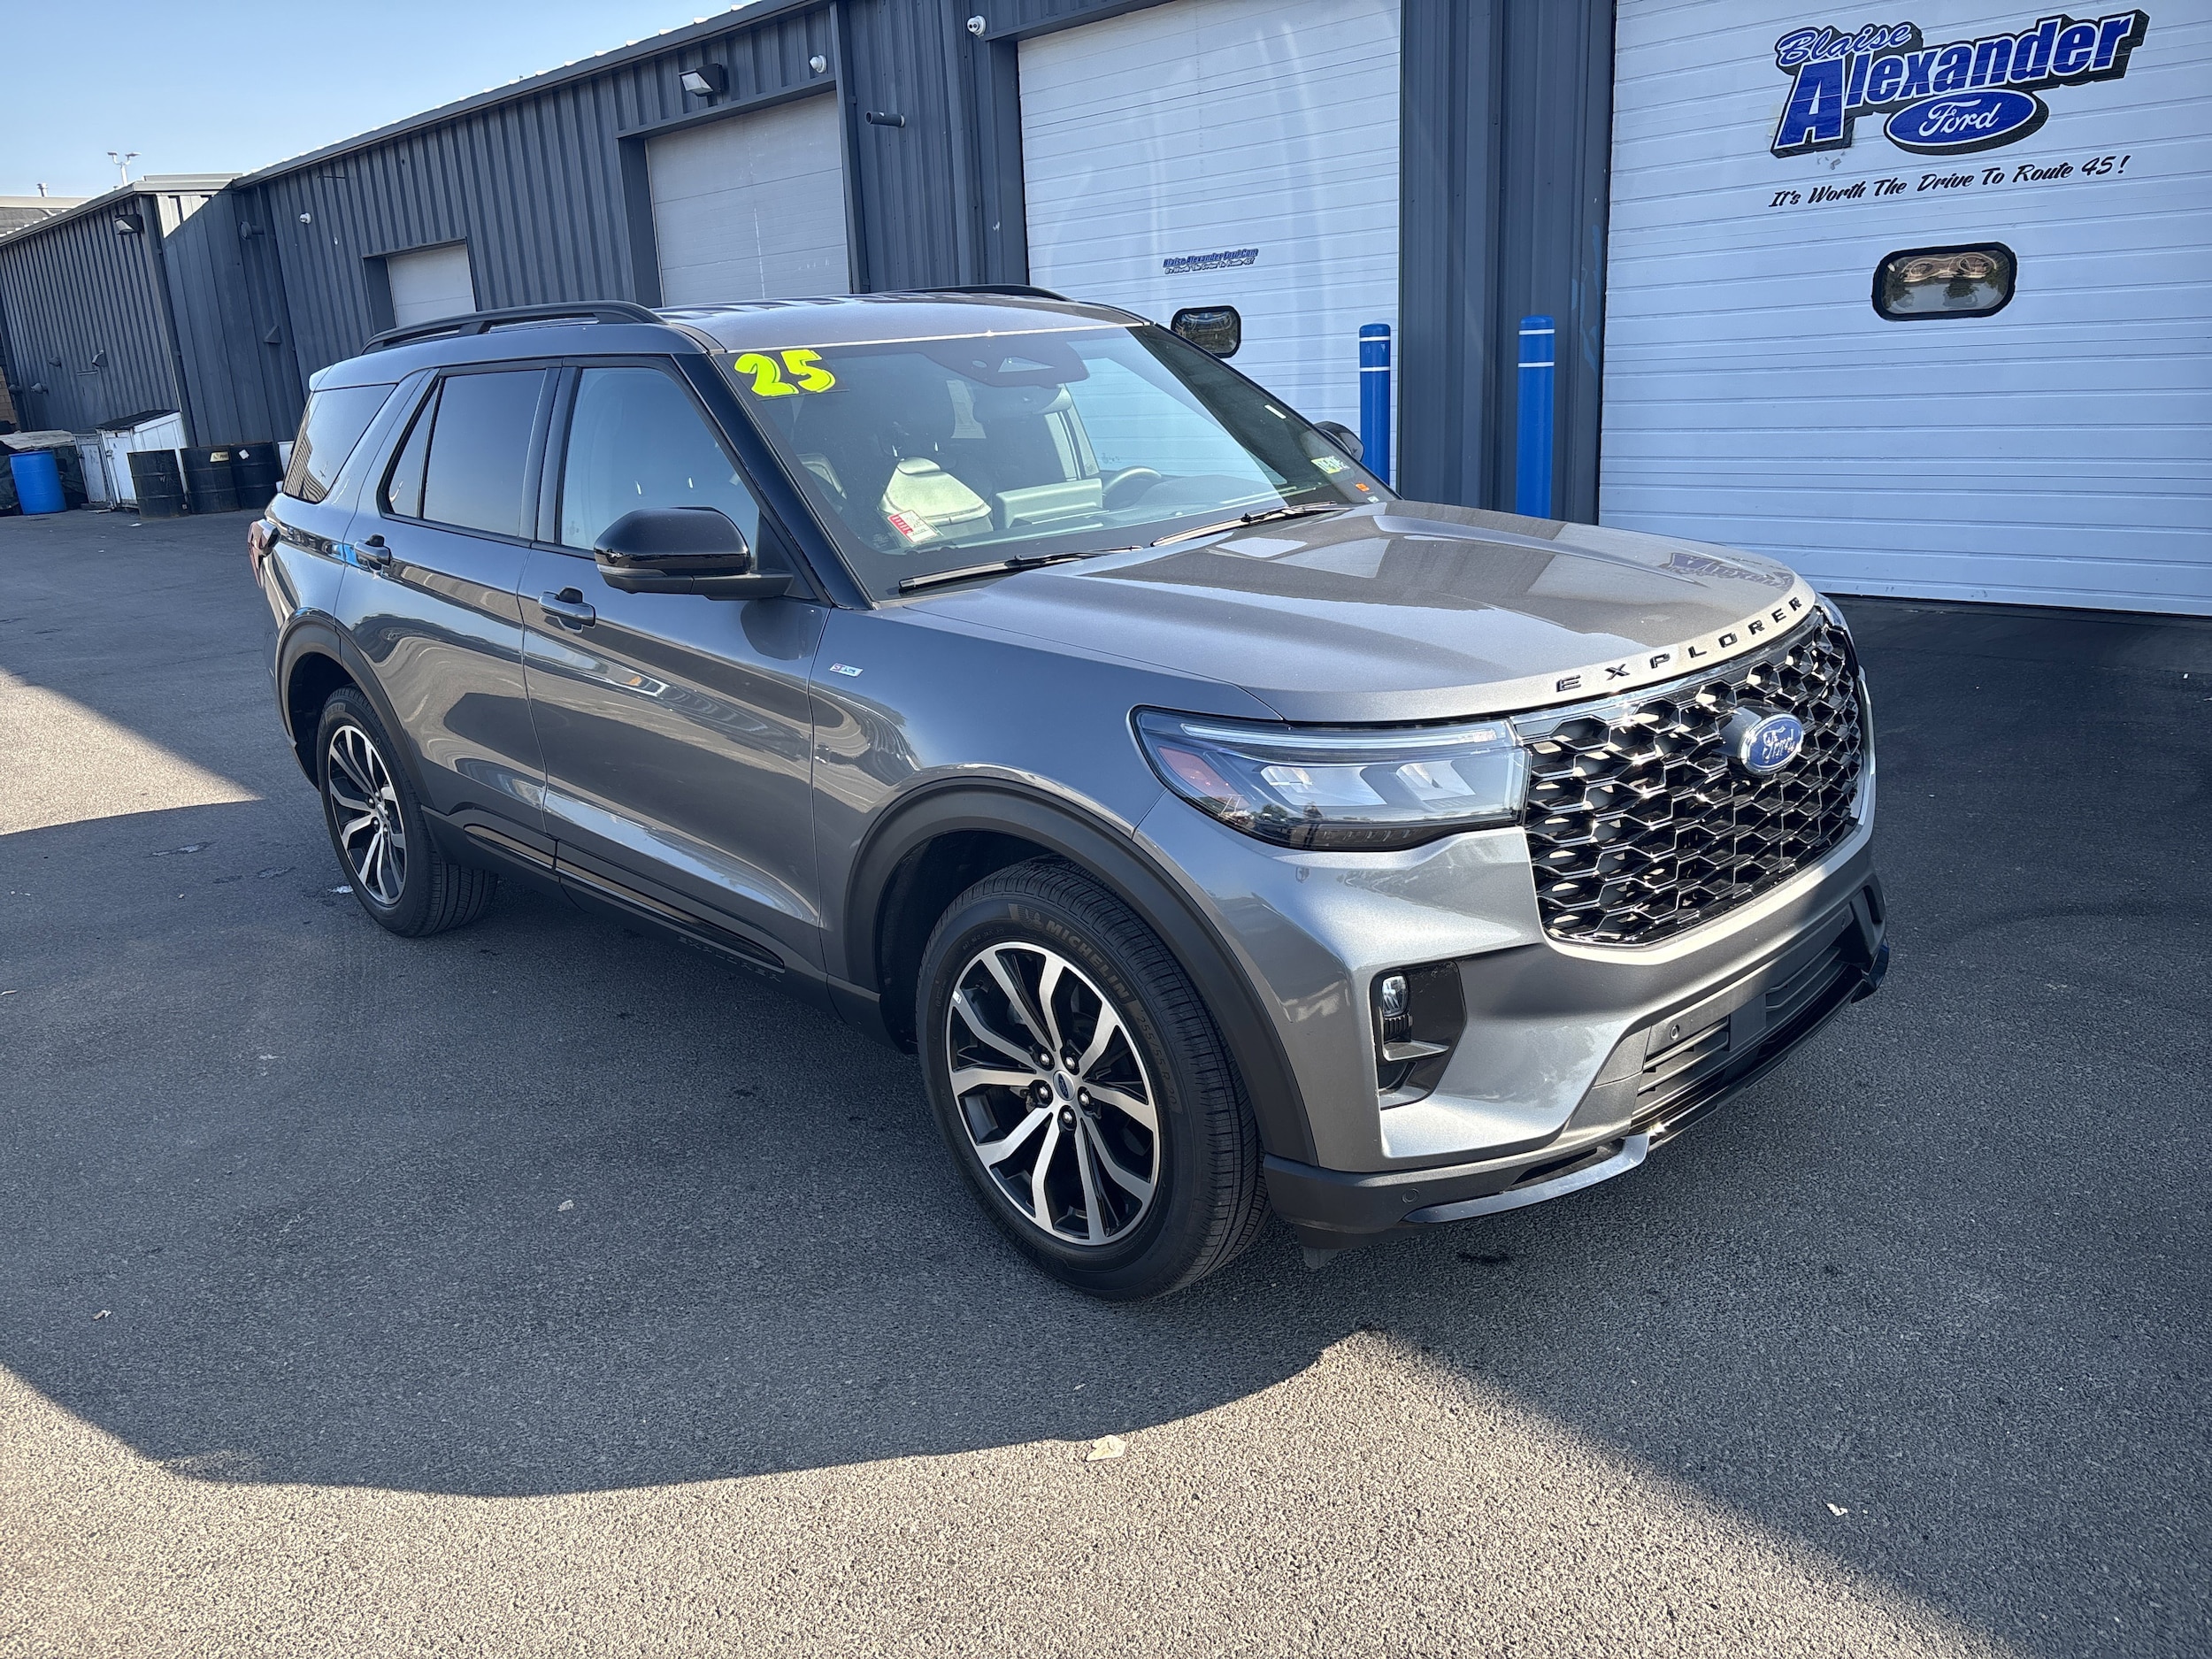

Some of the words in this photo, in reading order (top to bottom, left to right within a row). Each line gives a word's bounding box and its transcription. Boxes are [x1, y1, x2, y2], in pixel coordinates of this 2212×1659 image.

[1778, 24, 1913, 66] Blaise
[1772, 12, 2138, 150] Alexander
[1918, 98, 2001, 136] Ford
[1768, 189, 1801, 208] It's
[1807, 180, 1867, 204] Worth
[1873, 177, 1908, 196] The
[1916, 173, 1975, 192] Drive
[1981, 166, 2006, 186] To
[2011, 161, 2074, 183] Route
[2081, 155, 2131, 176] 45!
[734, 349, 836, 397] 25
[1555, 596, 1803, 693] EXPLORER
[1046, 919, 1131, 999] MICHELIN
